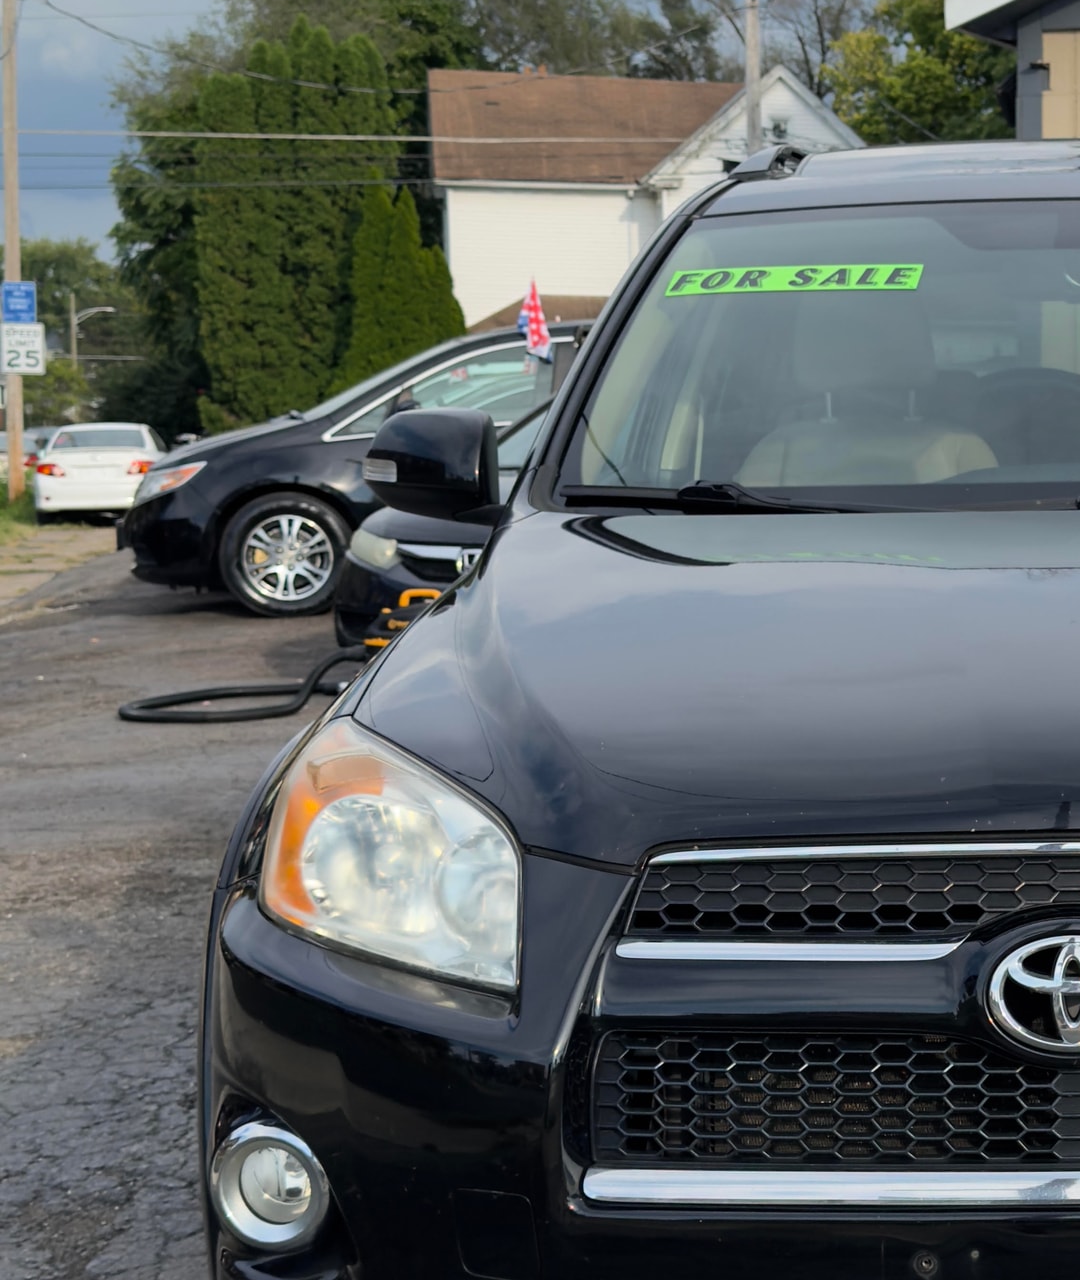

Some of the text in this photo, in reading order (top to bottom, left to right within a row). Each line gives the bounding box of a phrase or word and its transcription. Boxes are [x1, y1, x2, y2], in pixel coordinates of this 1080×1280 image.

[669, 266, 919, 293] FOR SALE
[5, 328, 41, 337] SPEED
[8, 339, 36, 348] LIMIT
[6, 349, 40, 369] 25
